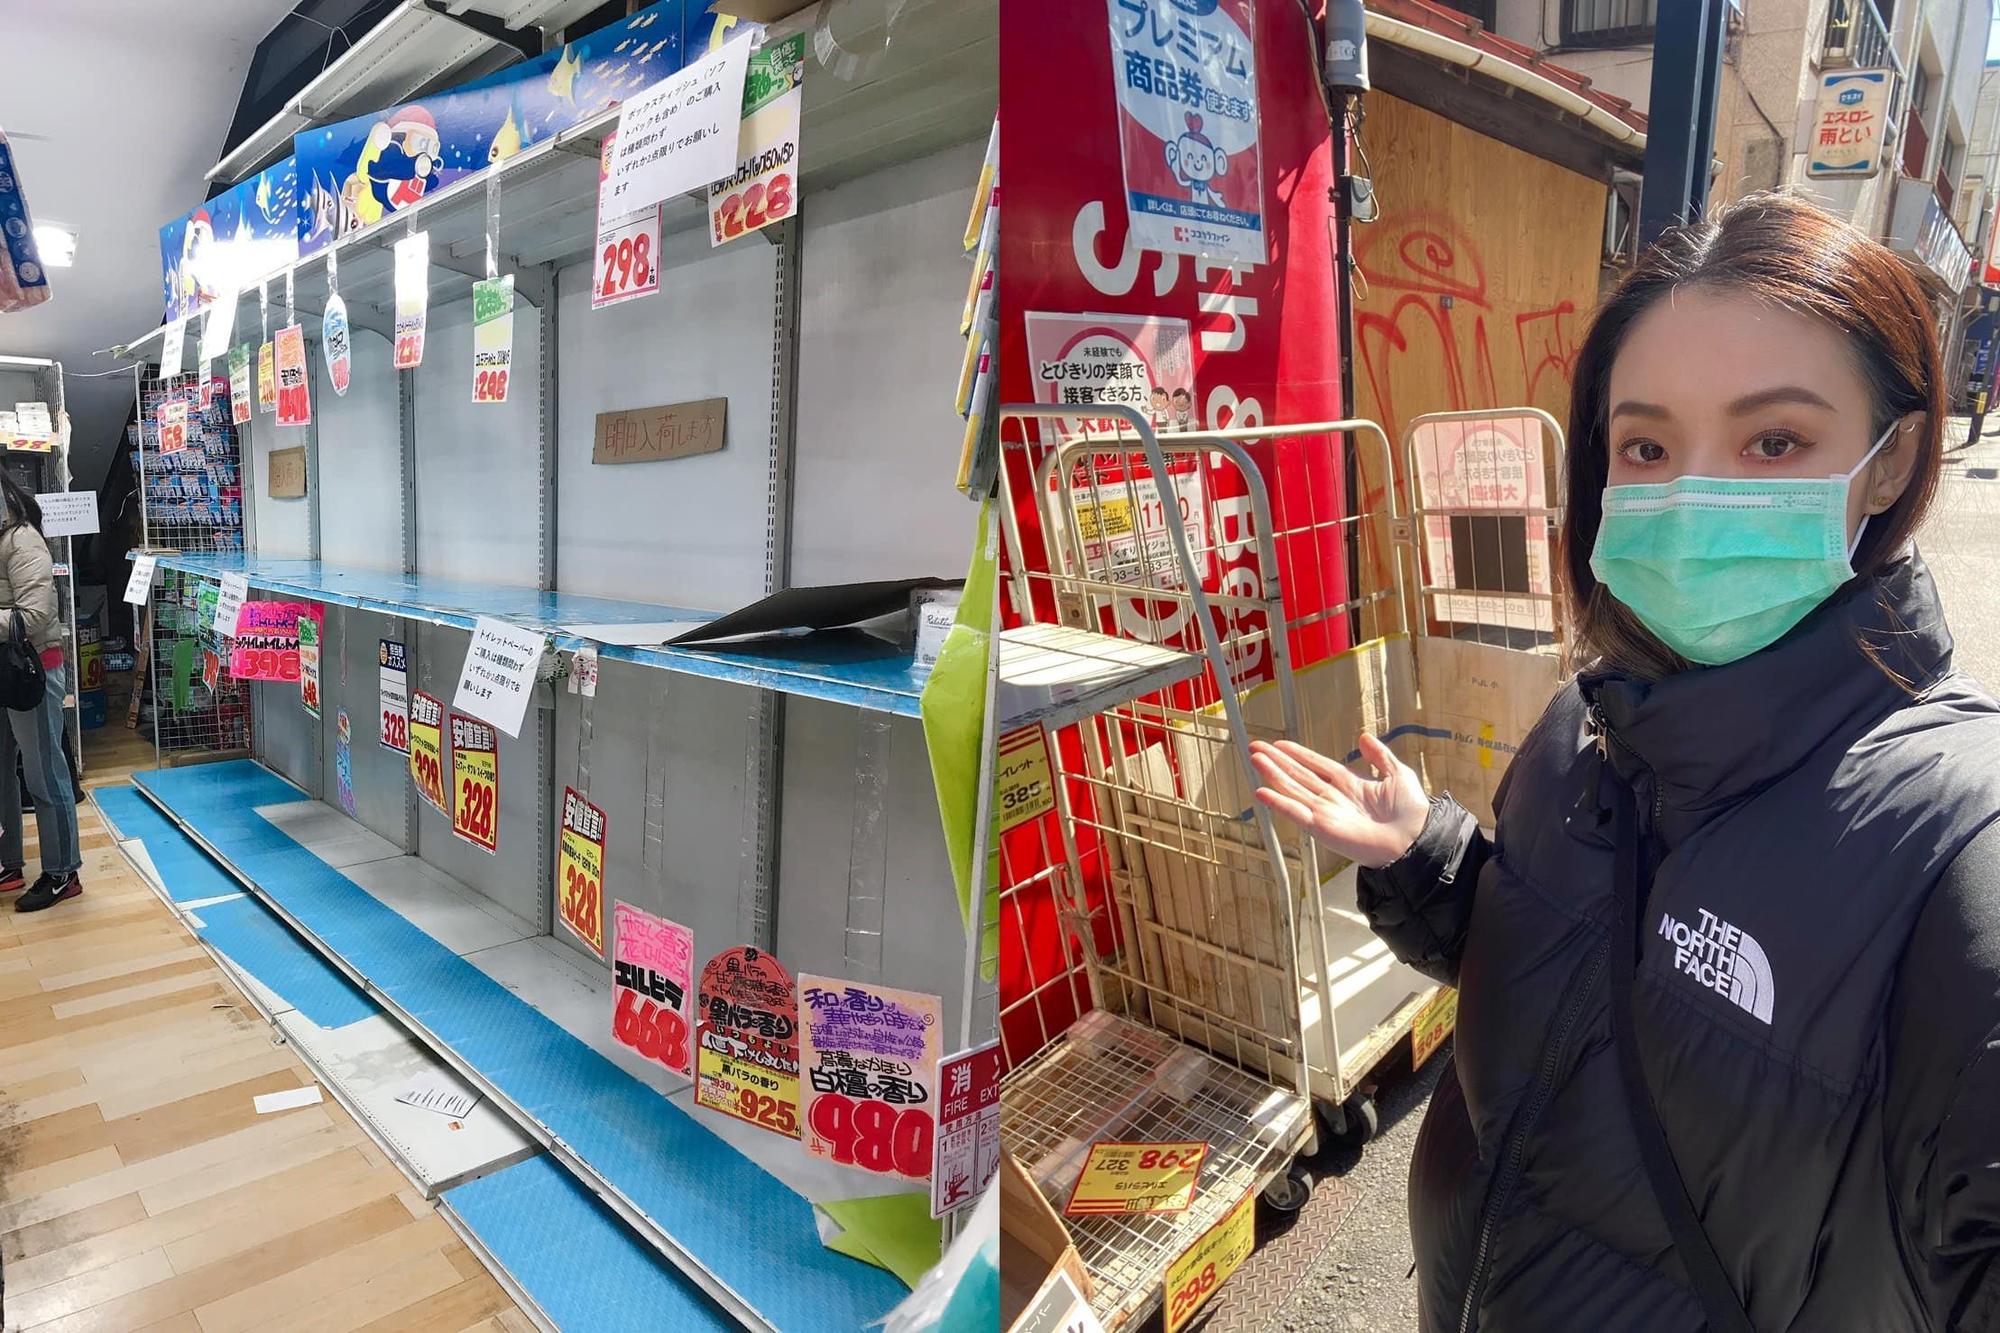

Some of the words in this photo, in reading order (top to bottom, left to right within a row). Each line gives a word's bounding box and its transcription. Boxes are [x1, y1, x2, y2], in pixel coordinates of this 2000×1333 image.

[1124, 49, 1202, 108] 商品券
[1822, 110, 1874, 125] エスロン
[1820, 127, 1872, 145] 雨とい
[615, 182, 629, 196] ます
[721, 173, 793, 237] 228
[602, 233, 650, 296] 298
[1083, 347, 1123, 357] 未経験でも
[1040, 362, 1144, 380] とびきりの笑顔で
[1064, 386, 1148, 404] 接客できる方、
[605, 413, 716, 457] 明日入荷します
[480, 629, 534, 657] トイレットペーパーの
[245, 651, 300, 679] 398
[474, 647, 525, 673] ご購入は種類問わず
[463, 679, 493, 700] 願いします
[383, 709, 406, 748] 328
[461, 778, 493, 840] 328
[1003, 781, 1041, 809] 385
[566, 864, 597, 940] 328
[1698, 907, 1741, 951] THE
[1658, 912, 1736, 976] NORTH
[614, 959, 684, 1012] エルビラ
[1674, 946, 1731, 998] FACE
[614, 988, 688, 1070] 668
[715, 1026, 789, 1053] いつもより
[722, 1063, 779, 1091] 黒バラの香り
[944, 1096, 968, 1118] FIRE
[808, 1094, 934, 1177] 980
[1095, 1160, 1130, 1171] 327
[1171, 1262, 1216, 1327] 298
